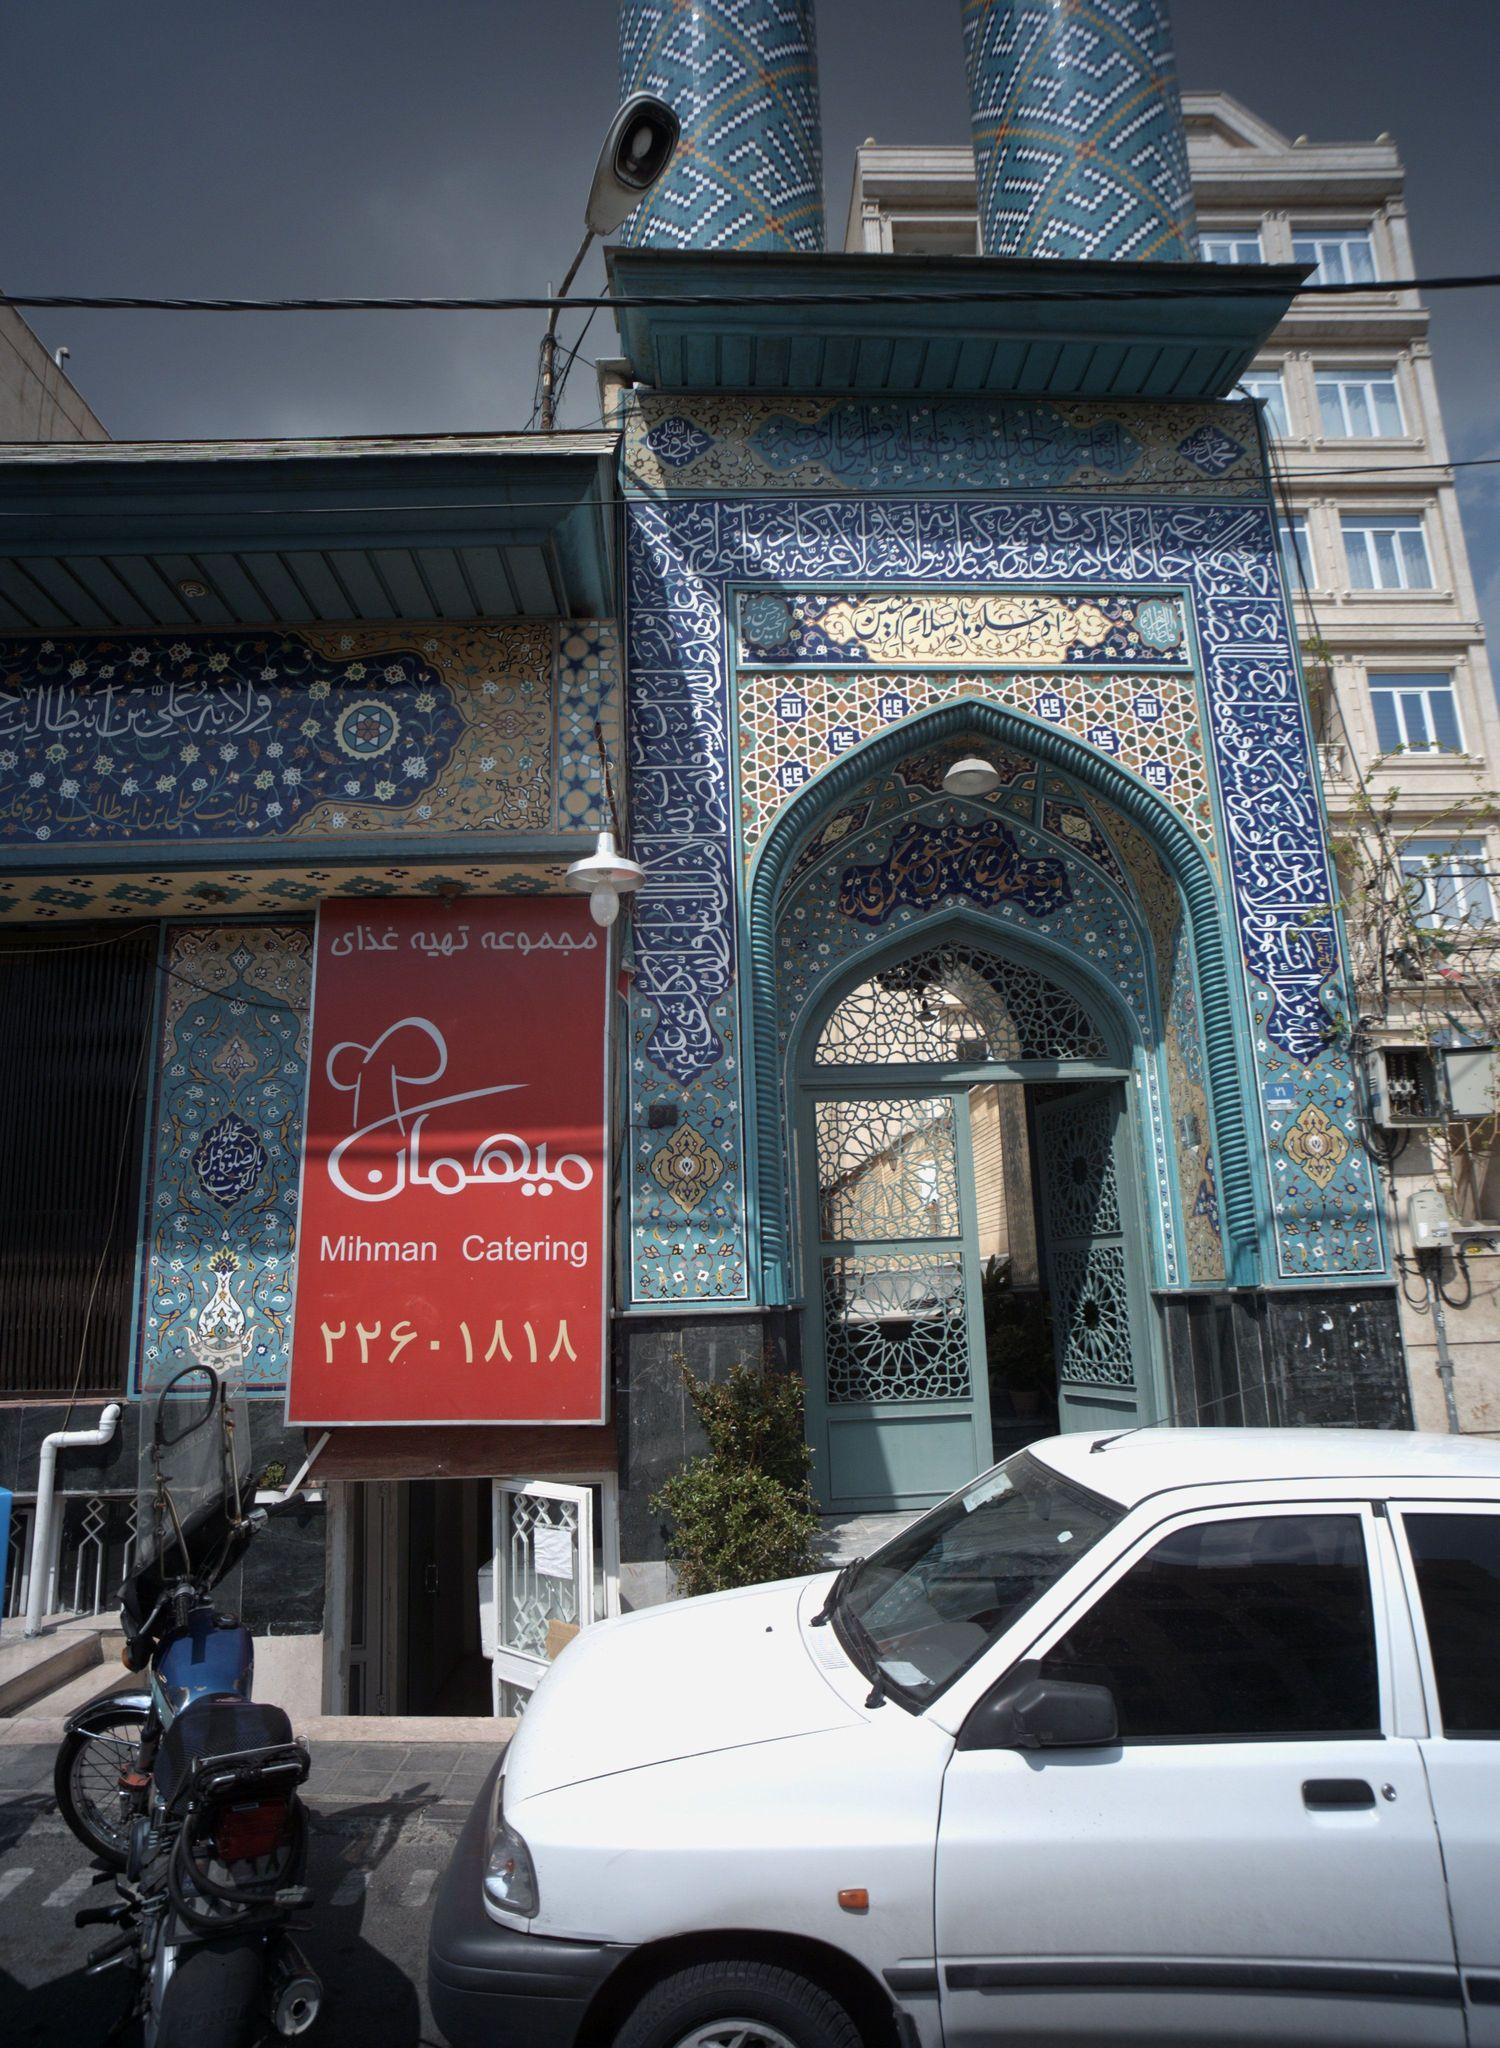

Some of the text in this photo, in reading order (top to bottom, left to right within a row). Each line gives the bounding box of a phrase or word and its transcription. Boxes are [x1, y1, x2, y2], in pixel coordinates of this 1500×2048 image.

[330, 925, 599, 957] مجموعه تهیه غذای
[327, 1083, 594, 1202] میهمان
[320, 1234, 589, 1267] Mihman Catering
[320, 1318, 578, 1364] ۲۲۶۰۱۸۱۸
